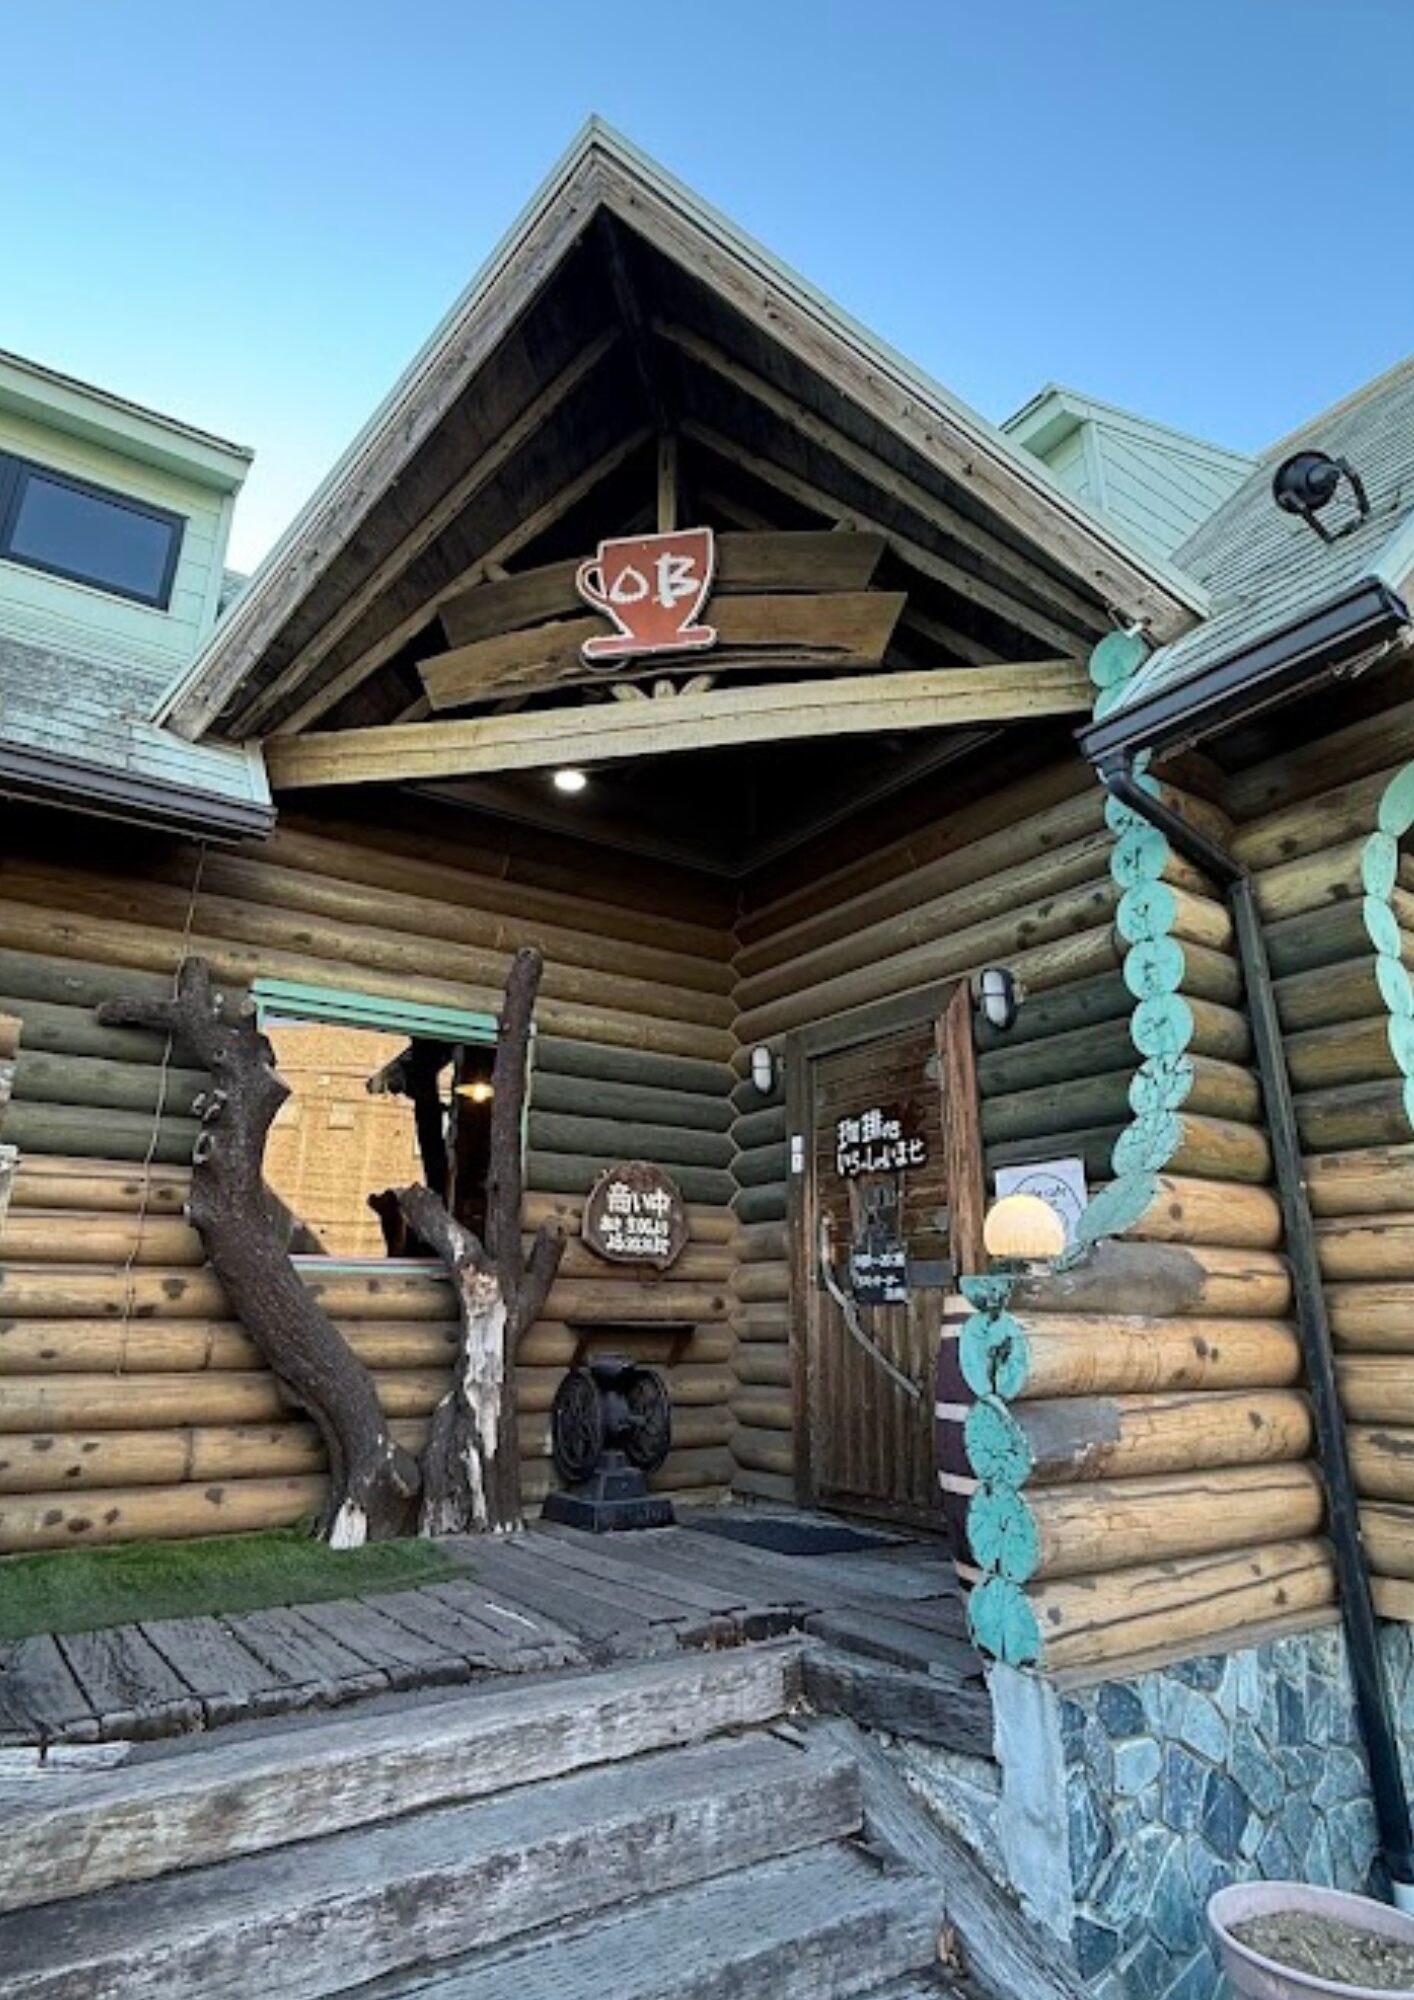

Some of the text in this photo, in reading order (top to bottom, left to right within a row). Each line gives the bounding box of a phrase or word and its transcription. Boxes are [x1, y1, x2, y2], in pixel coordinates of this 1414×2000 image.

[610, 553, 701, 608] OB
[607, 1181, 671, 1217] 商い中
